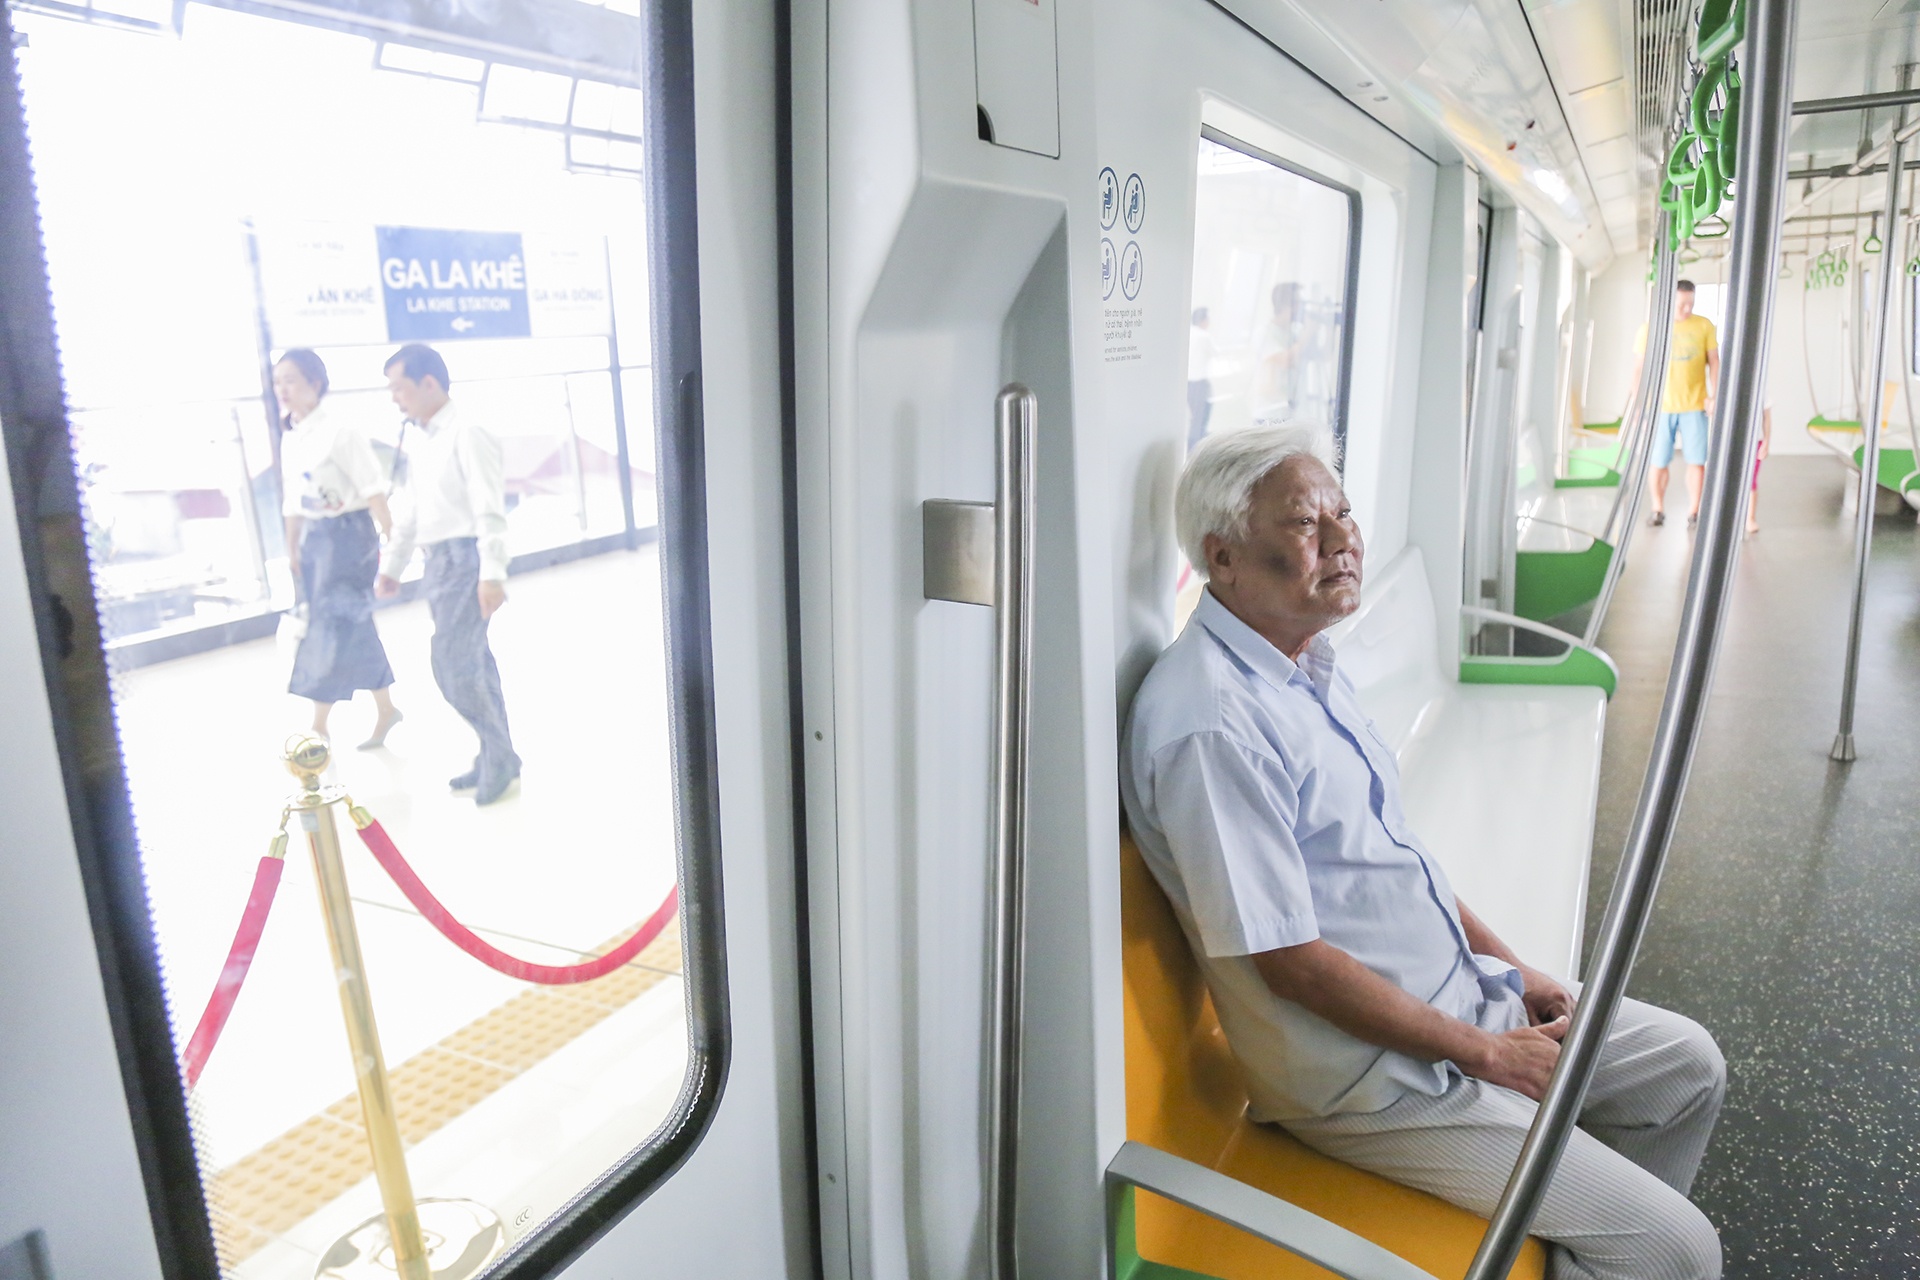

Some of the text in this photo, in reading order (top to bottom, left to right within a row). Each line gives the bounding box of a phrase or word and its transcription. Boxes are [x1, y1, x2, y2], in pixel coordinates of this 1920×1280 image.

[383, 253, 525, 290] GA LA KHÊ
[406, 296, 427, 313] LA
[458, 296, 512, 312] STATION
